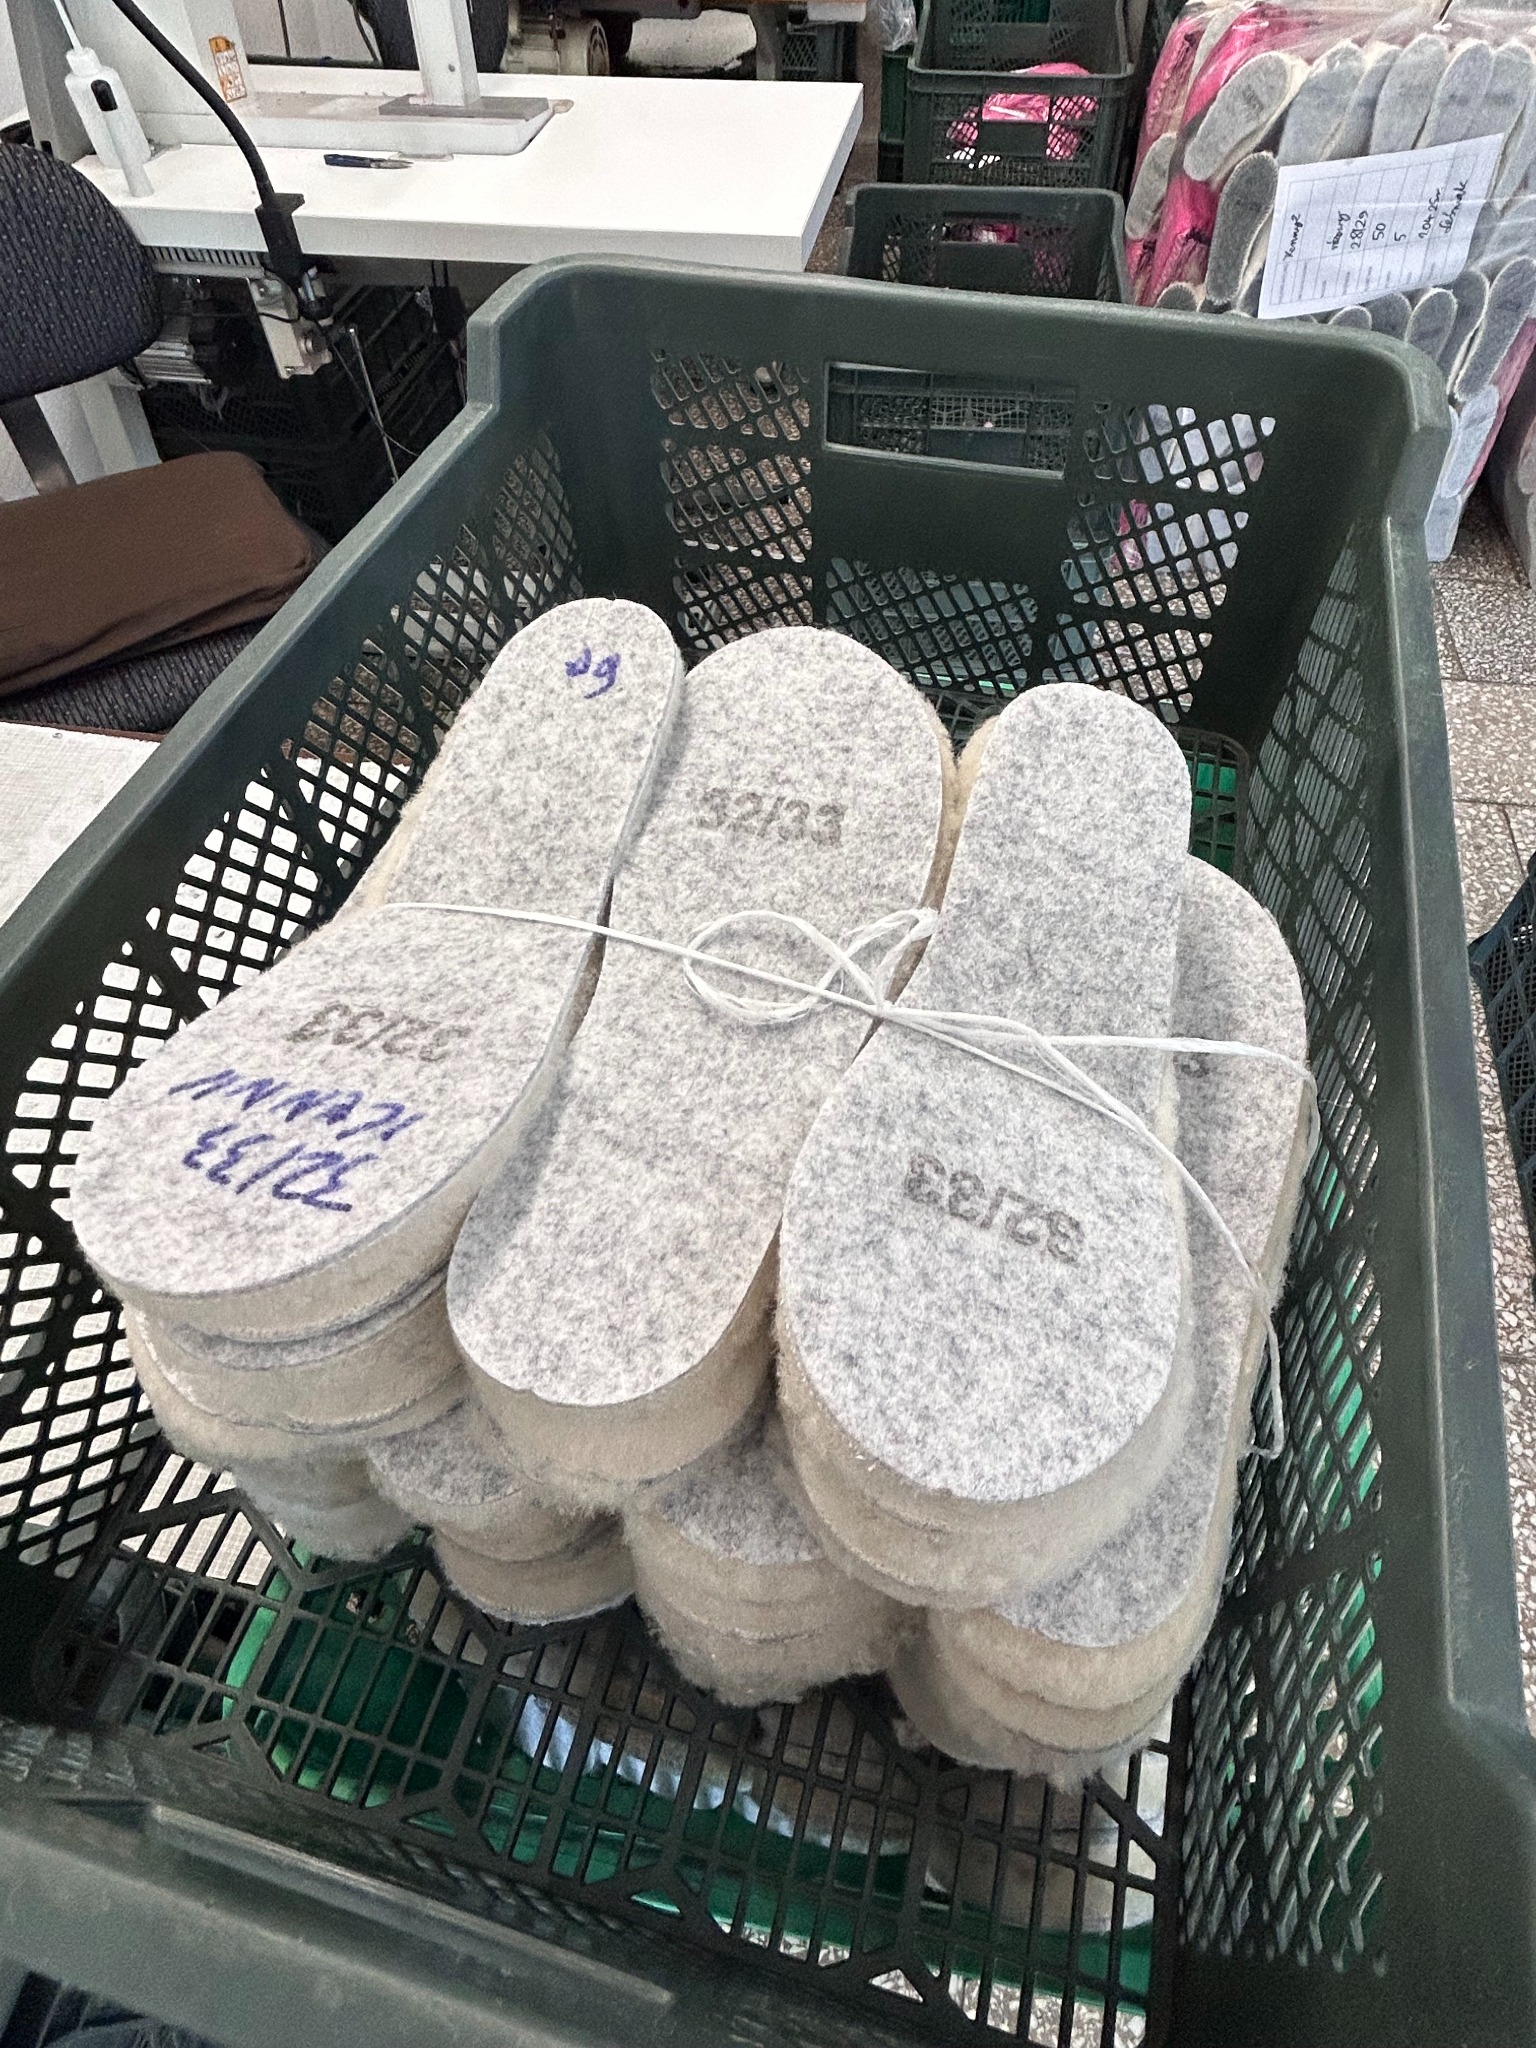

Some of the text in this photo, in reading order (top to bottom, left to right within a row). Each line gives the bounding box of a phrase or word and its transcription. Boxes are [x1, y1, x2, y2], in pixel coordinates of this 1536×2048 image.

[1371, 222, 1387, 241] 50
[1394, 232, 1407, 242] 5
[182, 1122, 378, 1213] 32/33
